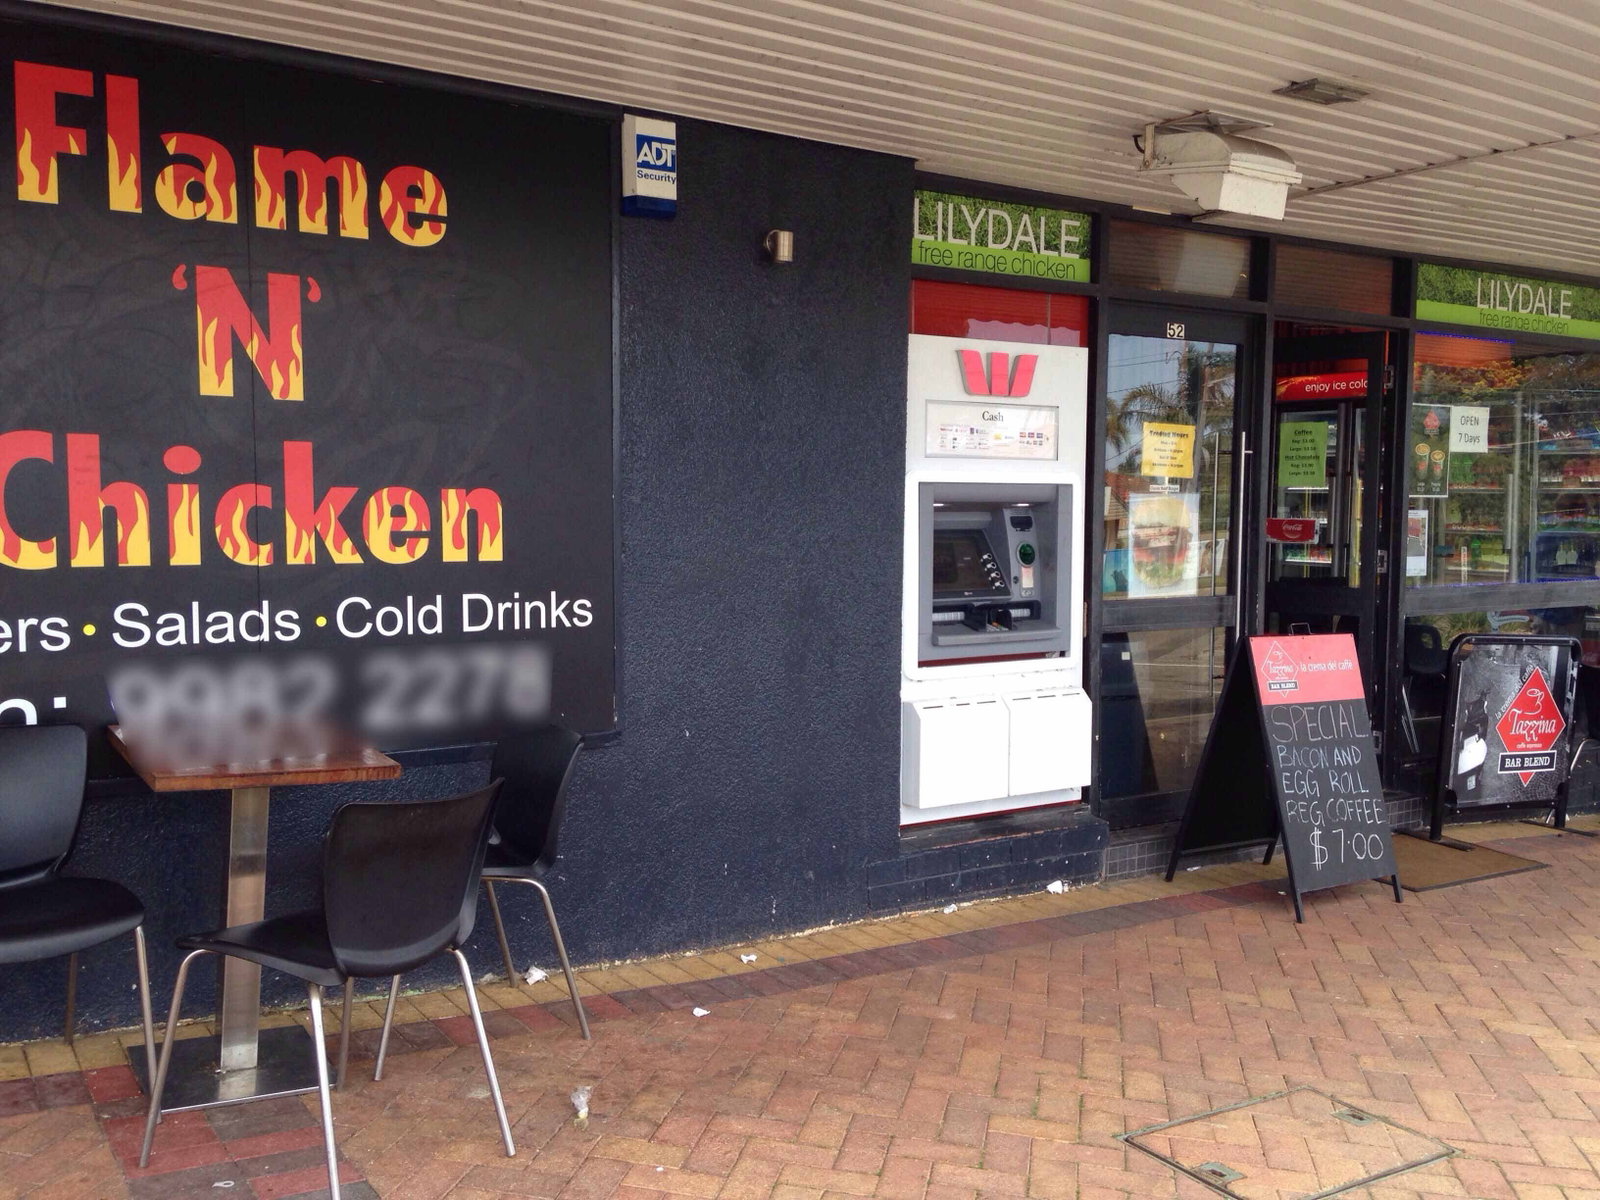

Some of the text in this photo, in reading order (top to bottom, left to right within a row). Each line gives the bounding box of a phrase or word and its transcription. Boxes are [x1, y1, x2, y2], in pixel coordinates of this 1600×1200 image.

[15, 61, 448, 248] Flame
[637, 141, 676, 168] ADT
[637, 170, 677, 185] Security
[914, 198, 1081, 259] LILYDALE
[919, 240, 1076, 280] free range chicken
[1477, 277, 1572, 319] LILYDALE
[1167, 324, 1184, 338] 52
[1480, 309, 1500, 328] free
[1531, 317, 1569, 335] chicken
[1305, 383, 1331, 393] enjoy
[1332, 381, 1347, 390] ice
[982, 410, 1004, 422] Cash
[1460, 415, 1480, 426] OPEN
[1458, 433, 1481, 444] 7 Days
[0, 429, 504, 570] Chicken
[113, 599, 300, 647] Salads
[336, 595, 443, 639] Cold
[462, 590, 593, 633] Drinks
[1300, 661, 1307, 672] la
[1308, 663, 1327, 672] crema
[1281, 682, 1296, 690] BLEND
[1271, 703, 1369, 743] SPECIAL
[1508, 708, 1557, 742] Tazzina
[1276, 744, 1362, 770] BACON AND
[1504, 756, 1551, 768] BAR BLEND
[1282, 769, 1370, 798] EGG ROLL
[1285, 798, 1387, 827] REG COFFEE
